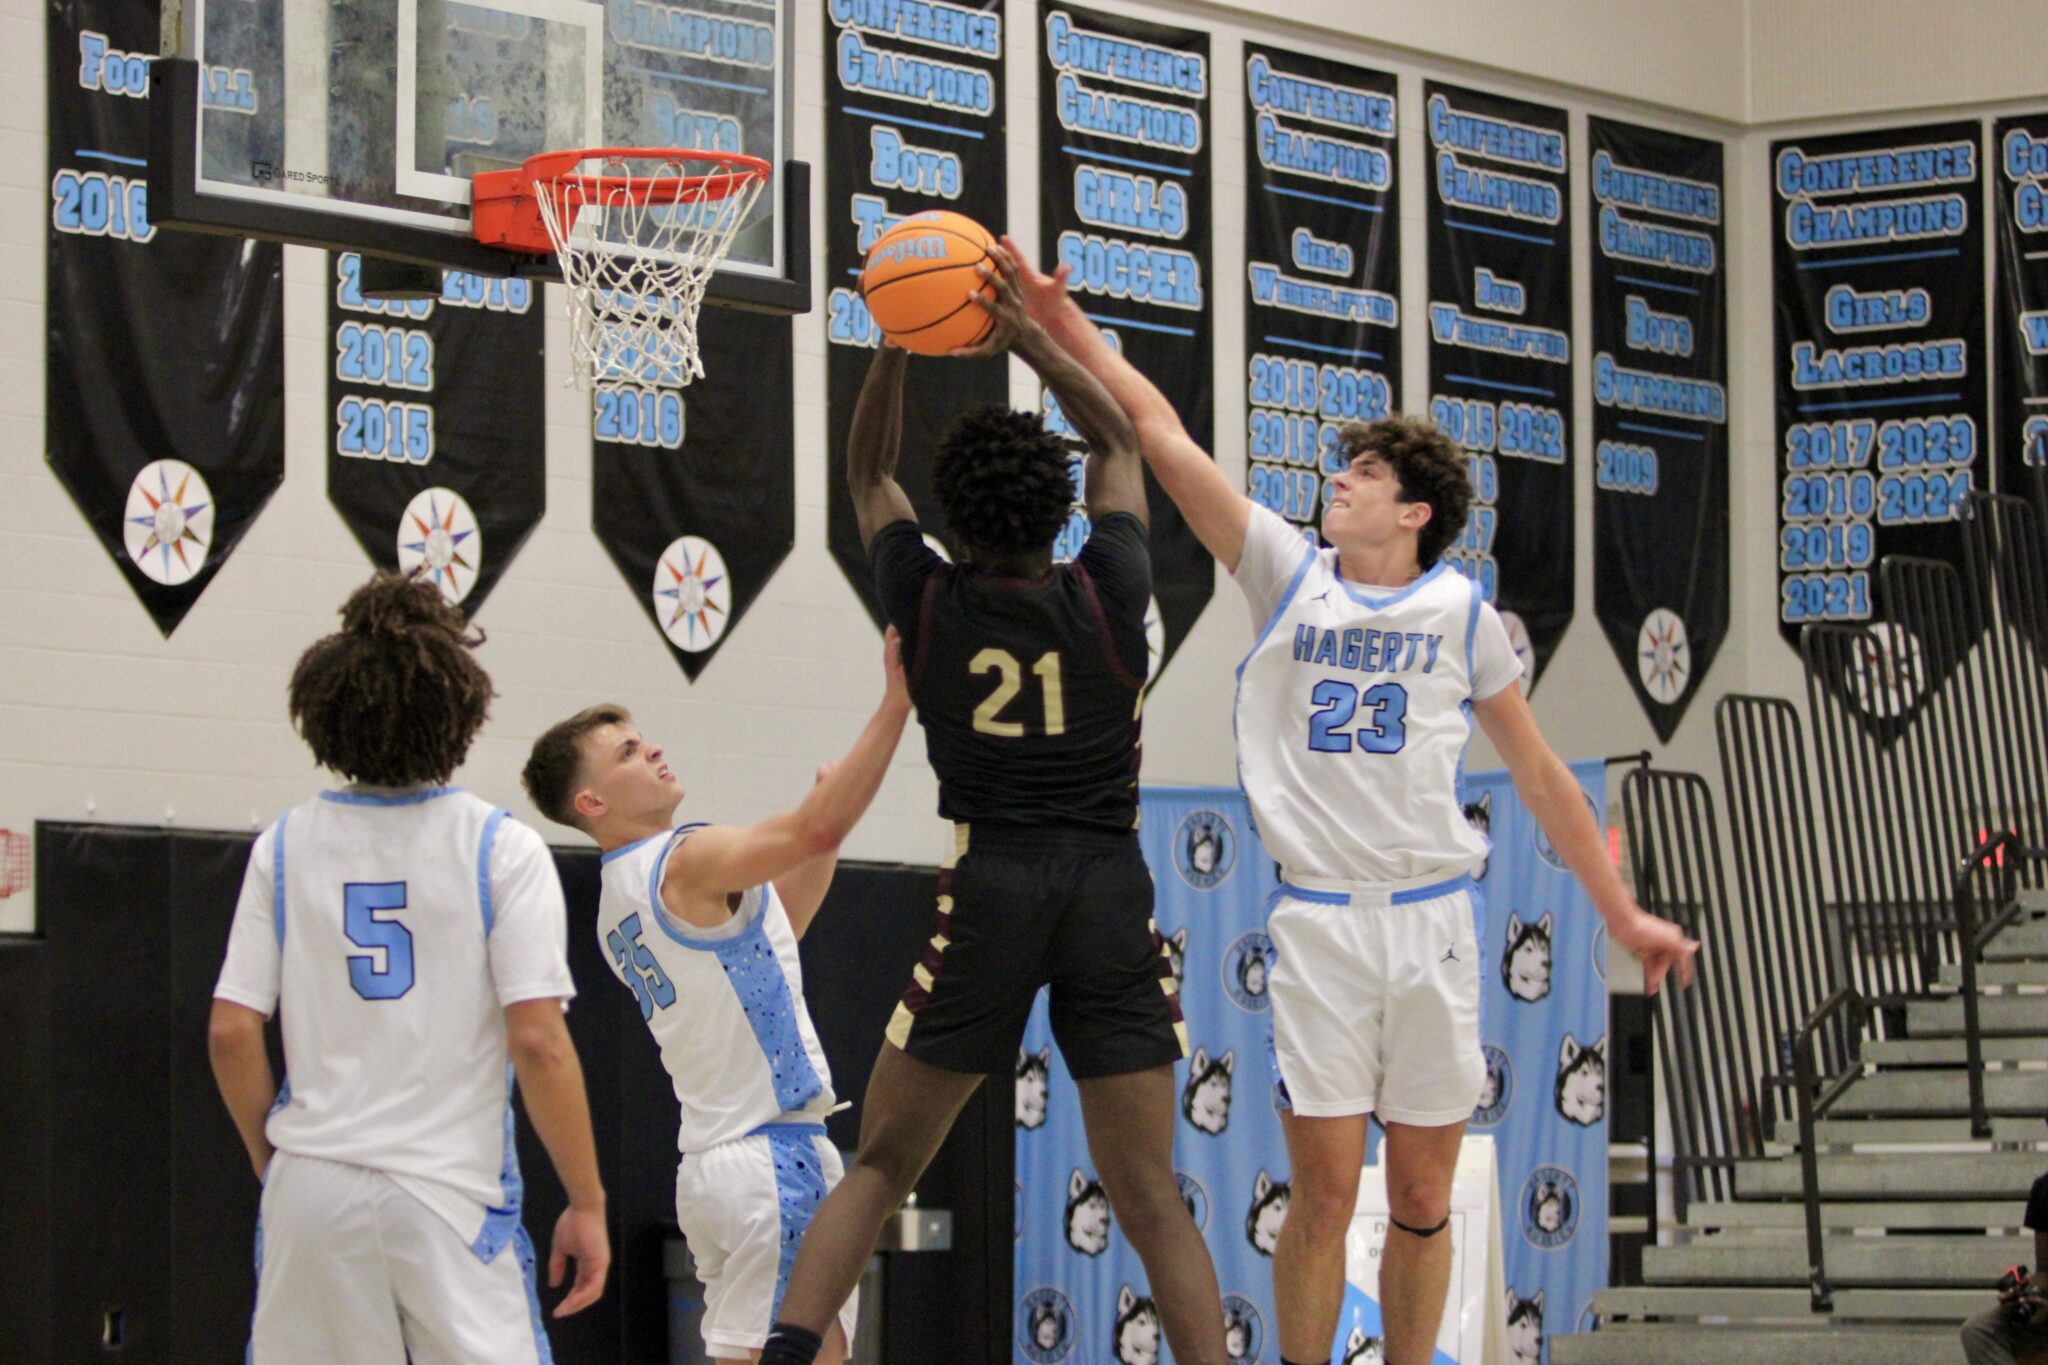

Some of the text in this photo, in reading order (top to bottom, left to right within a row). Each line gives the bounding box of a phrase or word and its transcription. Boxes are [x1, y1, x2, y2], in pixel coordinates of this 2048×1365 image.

[53, 169, 157, 243] 2016
[1074, 164, 1189, 240] GIRLS
[1057, 231, 1203, 311] SOCCER
[828, 287, 882, 349] 20
[337, 320, 434, 392] 2012
[1249, 353, 1318, 413] 2015
[337, 395, 434, 466] 2015
[594, 382, 685, 449] 2016
[1429, 394, 1566, 464] 2015 2022
[1786, 418, 1876, 472] 2017
[1878, 414, 1976, 473] 2023
[1249, 462, 1320, 523] 2017
[1597, 439, 1659, 497] 2009
[1783, 470, 1875, 521] 2018
[1781, 521, 1874, 572] 2019
[1782, 570, 1873, 623] 2021
[1293, 623, 1443, 673] HAGERTY
[969, 648, 1065, 737] 21
[1308, 678, 1408, 754] 23
[343, 881, 415, 1000] 5
[606, 911, 677, 1023] 35
